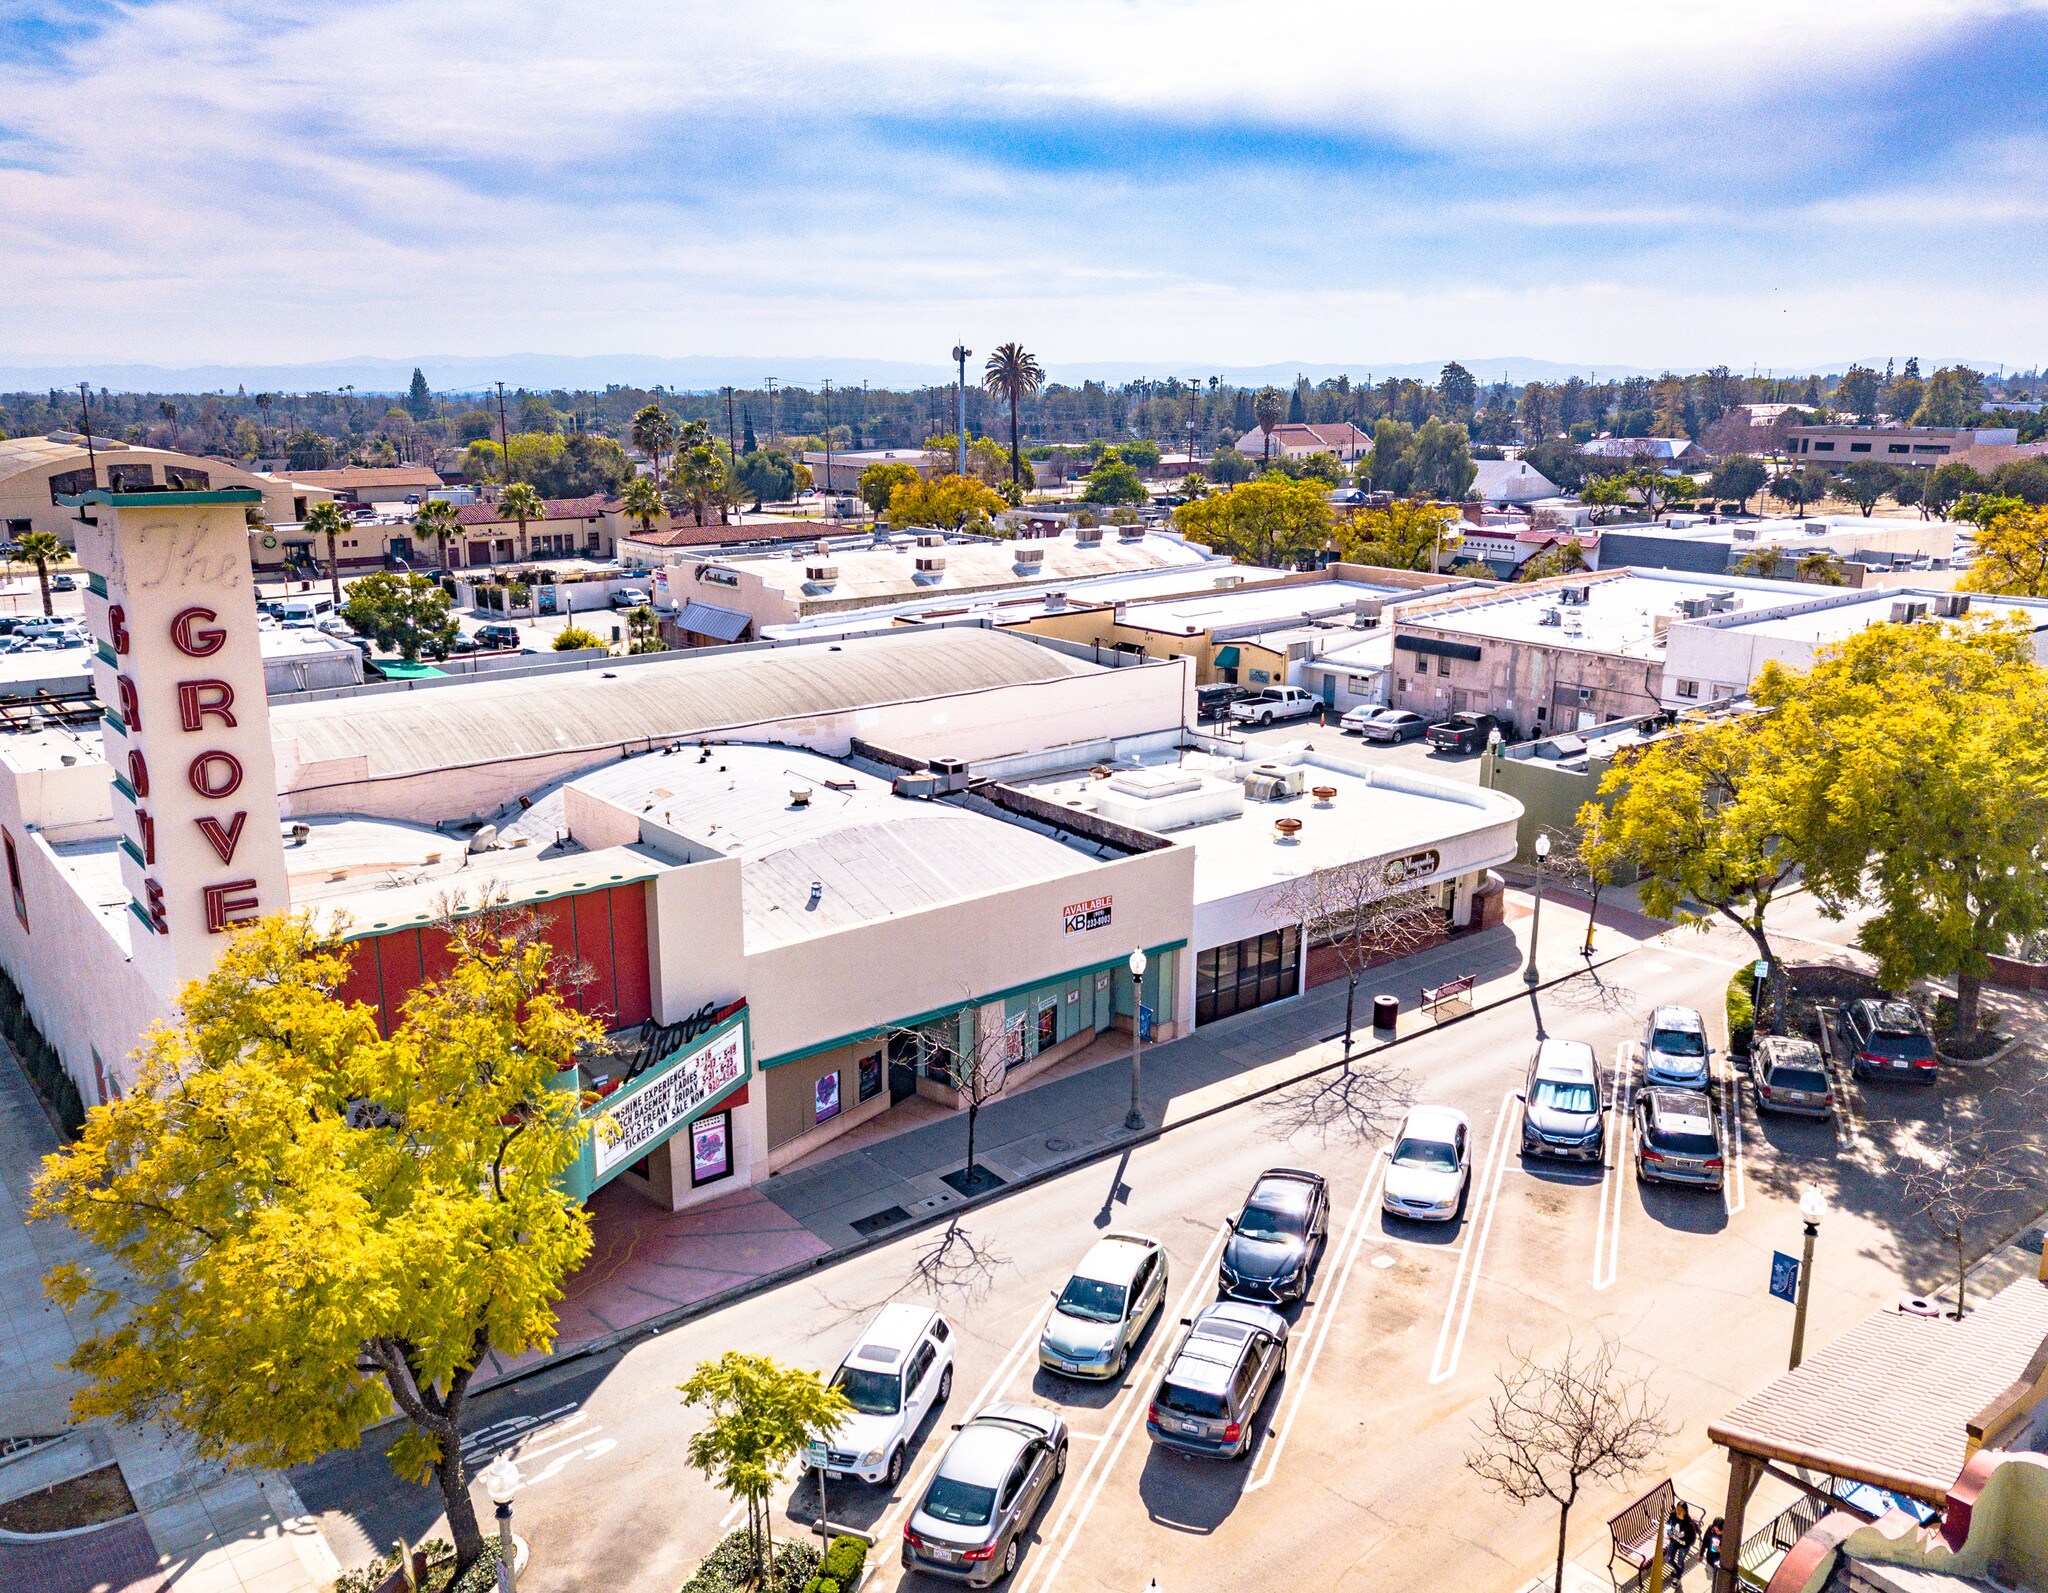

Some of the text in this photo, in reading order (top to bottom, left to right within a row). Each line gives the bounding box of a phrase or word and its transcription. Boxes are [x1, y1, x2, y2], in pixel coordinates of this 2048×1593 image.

[139, 514, 242, 588] The
[108, 604, 169, 935] GROVE
[170, 606, 260, 934] GROVE
[1064, 896, 1112, 916] AVAILABLE
[1065, 914, 1086, 934] KB
[624, 1001, 714, 1084] Grove
[634, 1088, 671, 1119] BASEMENT
[674, 1070, 698, 1093] LADIES
[643, 1100, 671, 1126] FREAKY
[674, 1081, 698, 1105] FRIDAY
[644, 1065, 686, 1102] EXPERIENCE
[624, 1123, 654, 1151] TICKETS
[658, 1113, 668, 1127] ON
[671, 1100, 688, 1119] SALE
[690, 1088, 705, 1106] NOW
